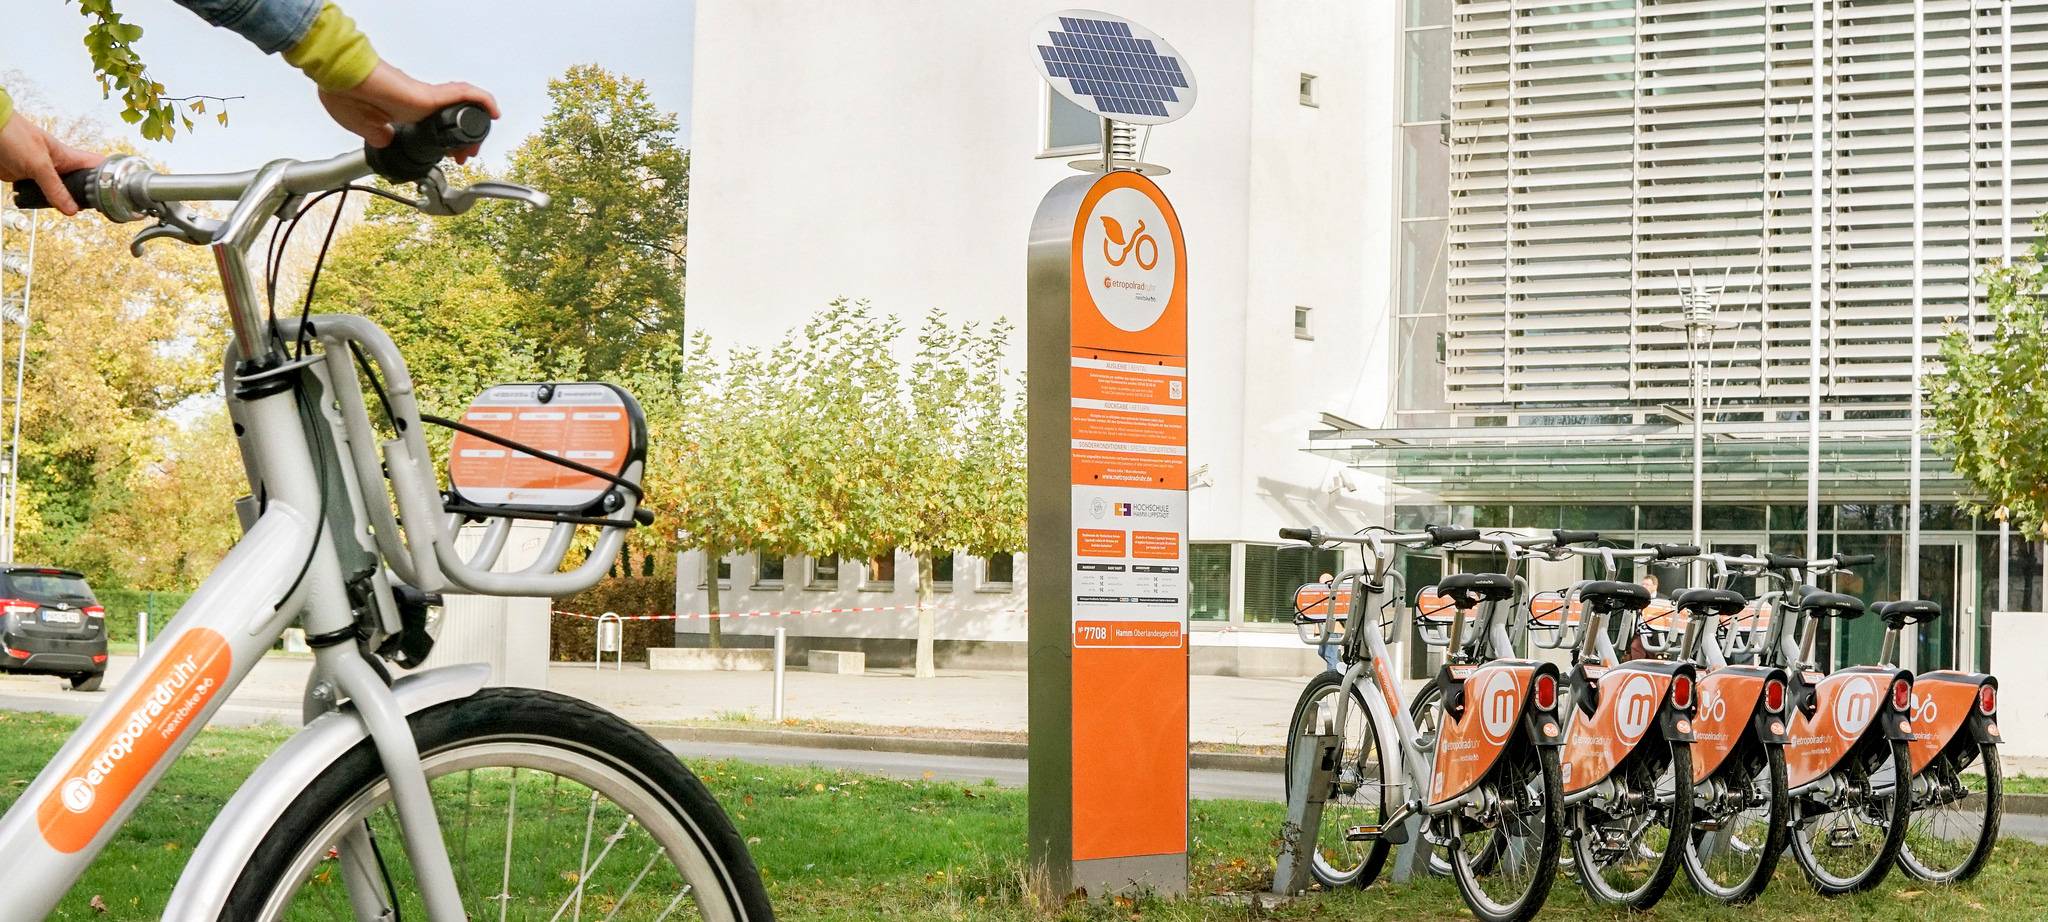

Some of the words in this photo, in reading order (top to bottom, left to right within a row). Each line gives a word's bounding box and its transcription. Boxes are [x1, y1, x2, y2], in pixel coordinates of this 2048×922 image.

[1134, 504, 1169, 512] HOCHSCHULE
[1084, 627, 1107, 640] 7708
[1115, 629, 1133, 637] Hamm
[1134, 629, 1178, 639] Oberlandesgericht
[161, 693, 202, 739] nextbike
[61, 654, 200, 813] metropolradruhr
